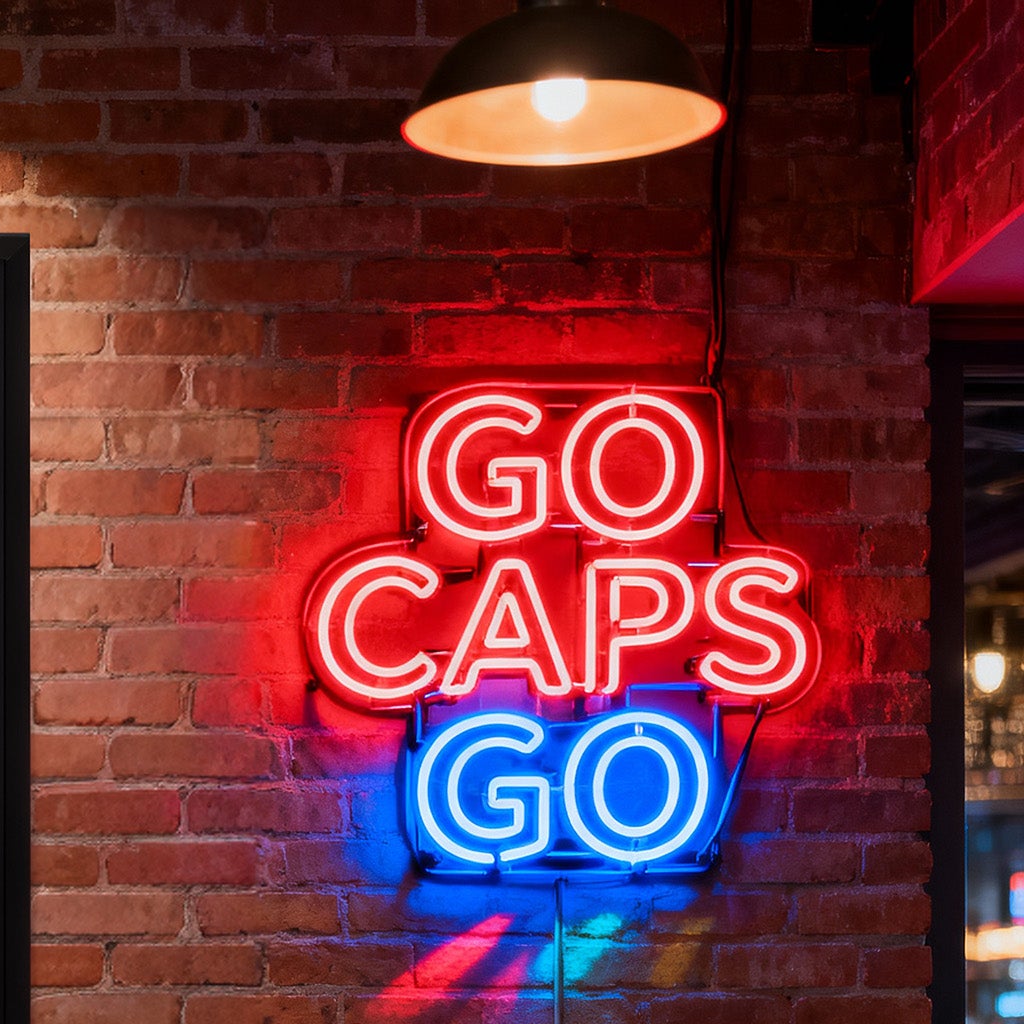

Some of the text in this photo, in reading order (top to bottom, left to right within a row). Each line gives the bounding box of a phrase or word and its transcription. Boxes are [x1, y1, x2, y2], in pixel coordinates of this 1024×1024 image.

[417, 393, 704, 541] GO
[318, 555, 807, 699] CAPS
[417, 712, 709, 864] GO
